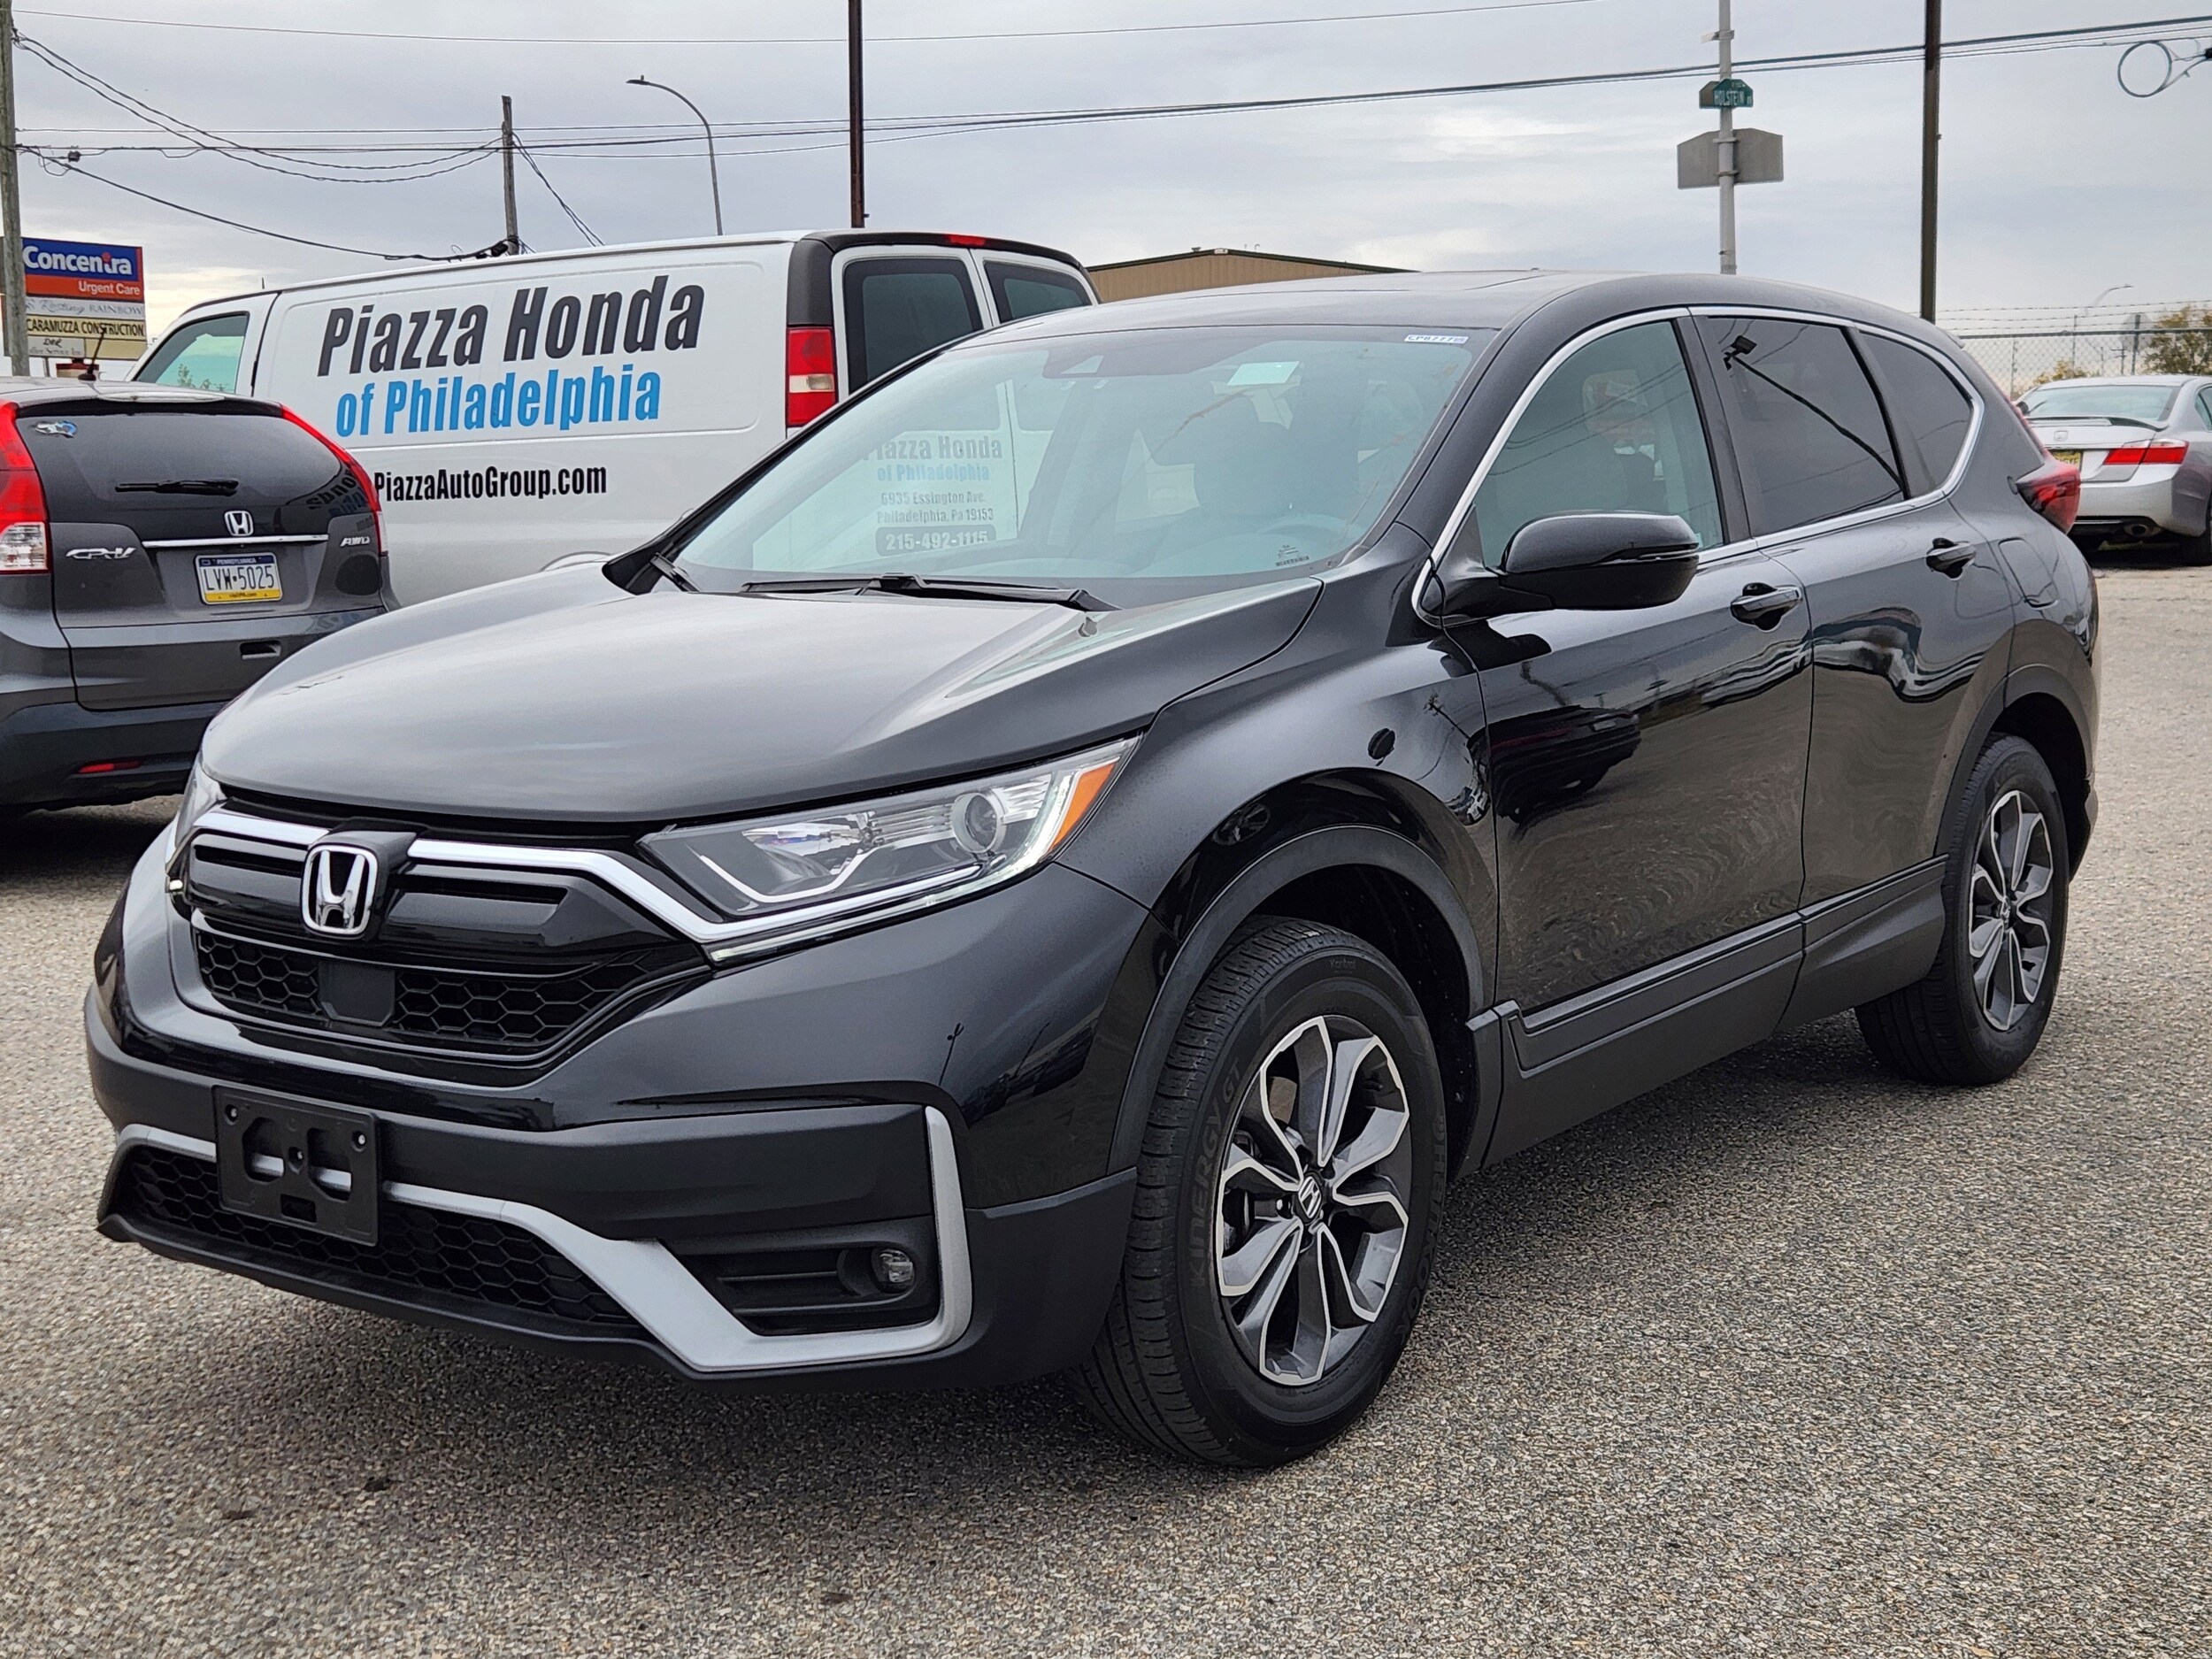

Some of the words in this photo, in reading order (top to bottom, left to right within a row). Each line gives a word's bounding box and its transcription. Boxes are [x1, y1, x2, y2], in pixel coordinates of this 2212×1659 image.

[22, 245, 133, 275] Concentra
[78, 280, 114, 296] Urgent
[116, 282, 141, 296] Care
[81, 321, 145, 337] CONSTRUCTION
[317, 303, 488, 378] Piazza
[503, 274, 705, 363] Honda
[336, 382, 375, 438] of
[384, 364, 661, 434] Philadelphia
[863, 438, 932, 461] iazza
[938, 434, 1003, 460] Honda
[877, 465, 892, 481] of
[896, 463, 990, 482] Philadelphia
[374, 465, 607, 503] PiazzaAutoGroup.com
[880, 492, 910, 506] 6935
[912, 492, 964, 508] Essington
[966, 491, 986, 503] Ave.
[877, 510, 949, 524] Philadelphia,
[951, 510, 964, 521] Pa
[965, 509, 995, 521] 19153
[340, 536, 371, 547] AWD
[886, 530, 988, 551] 215-492-1115
